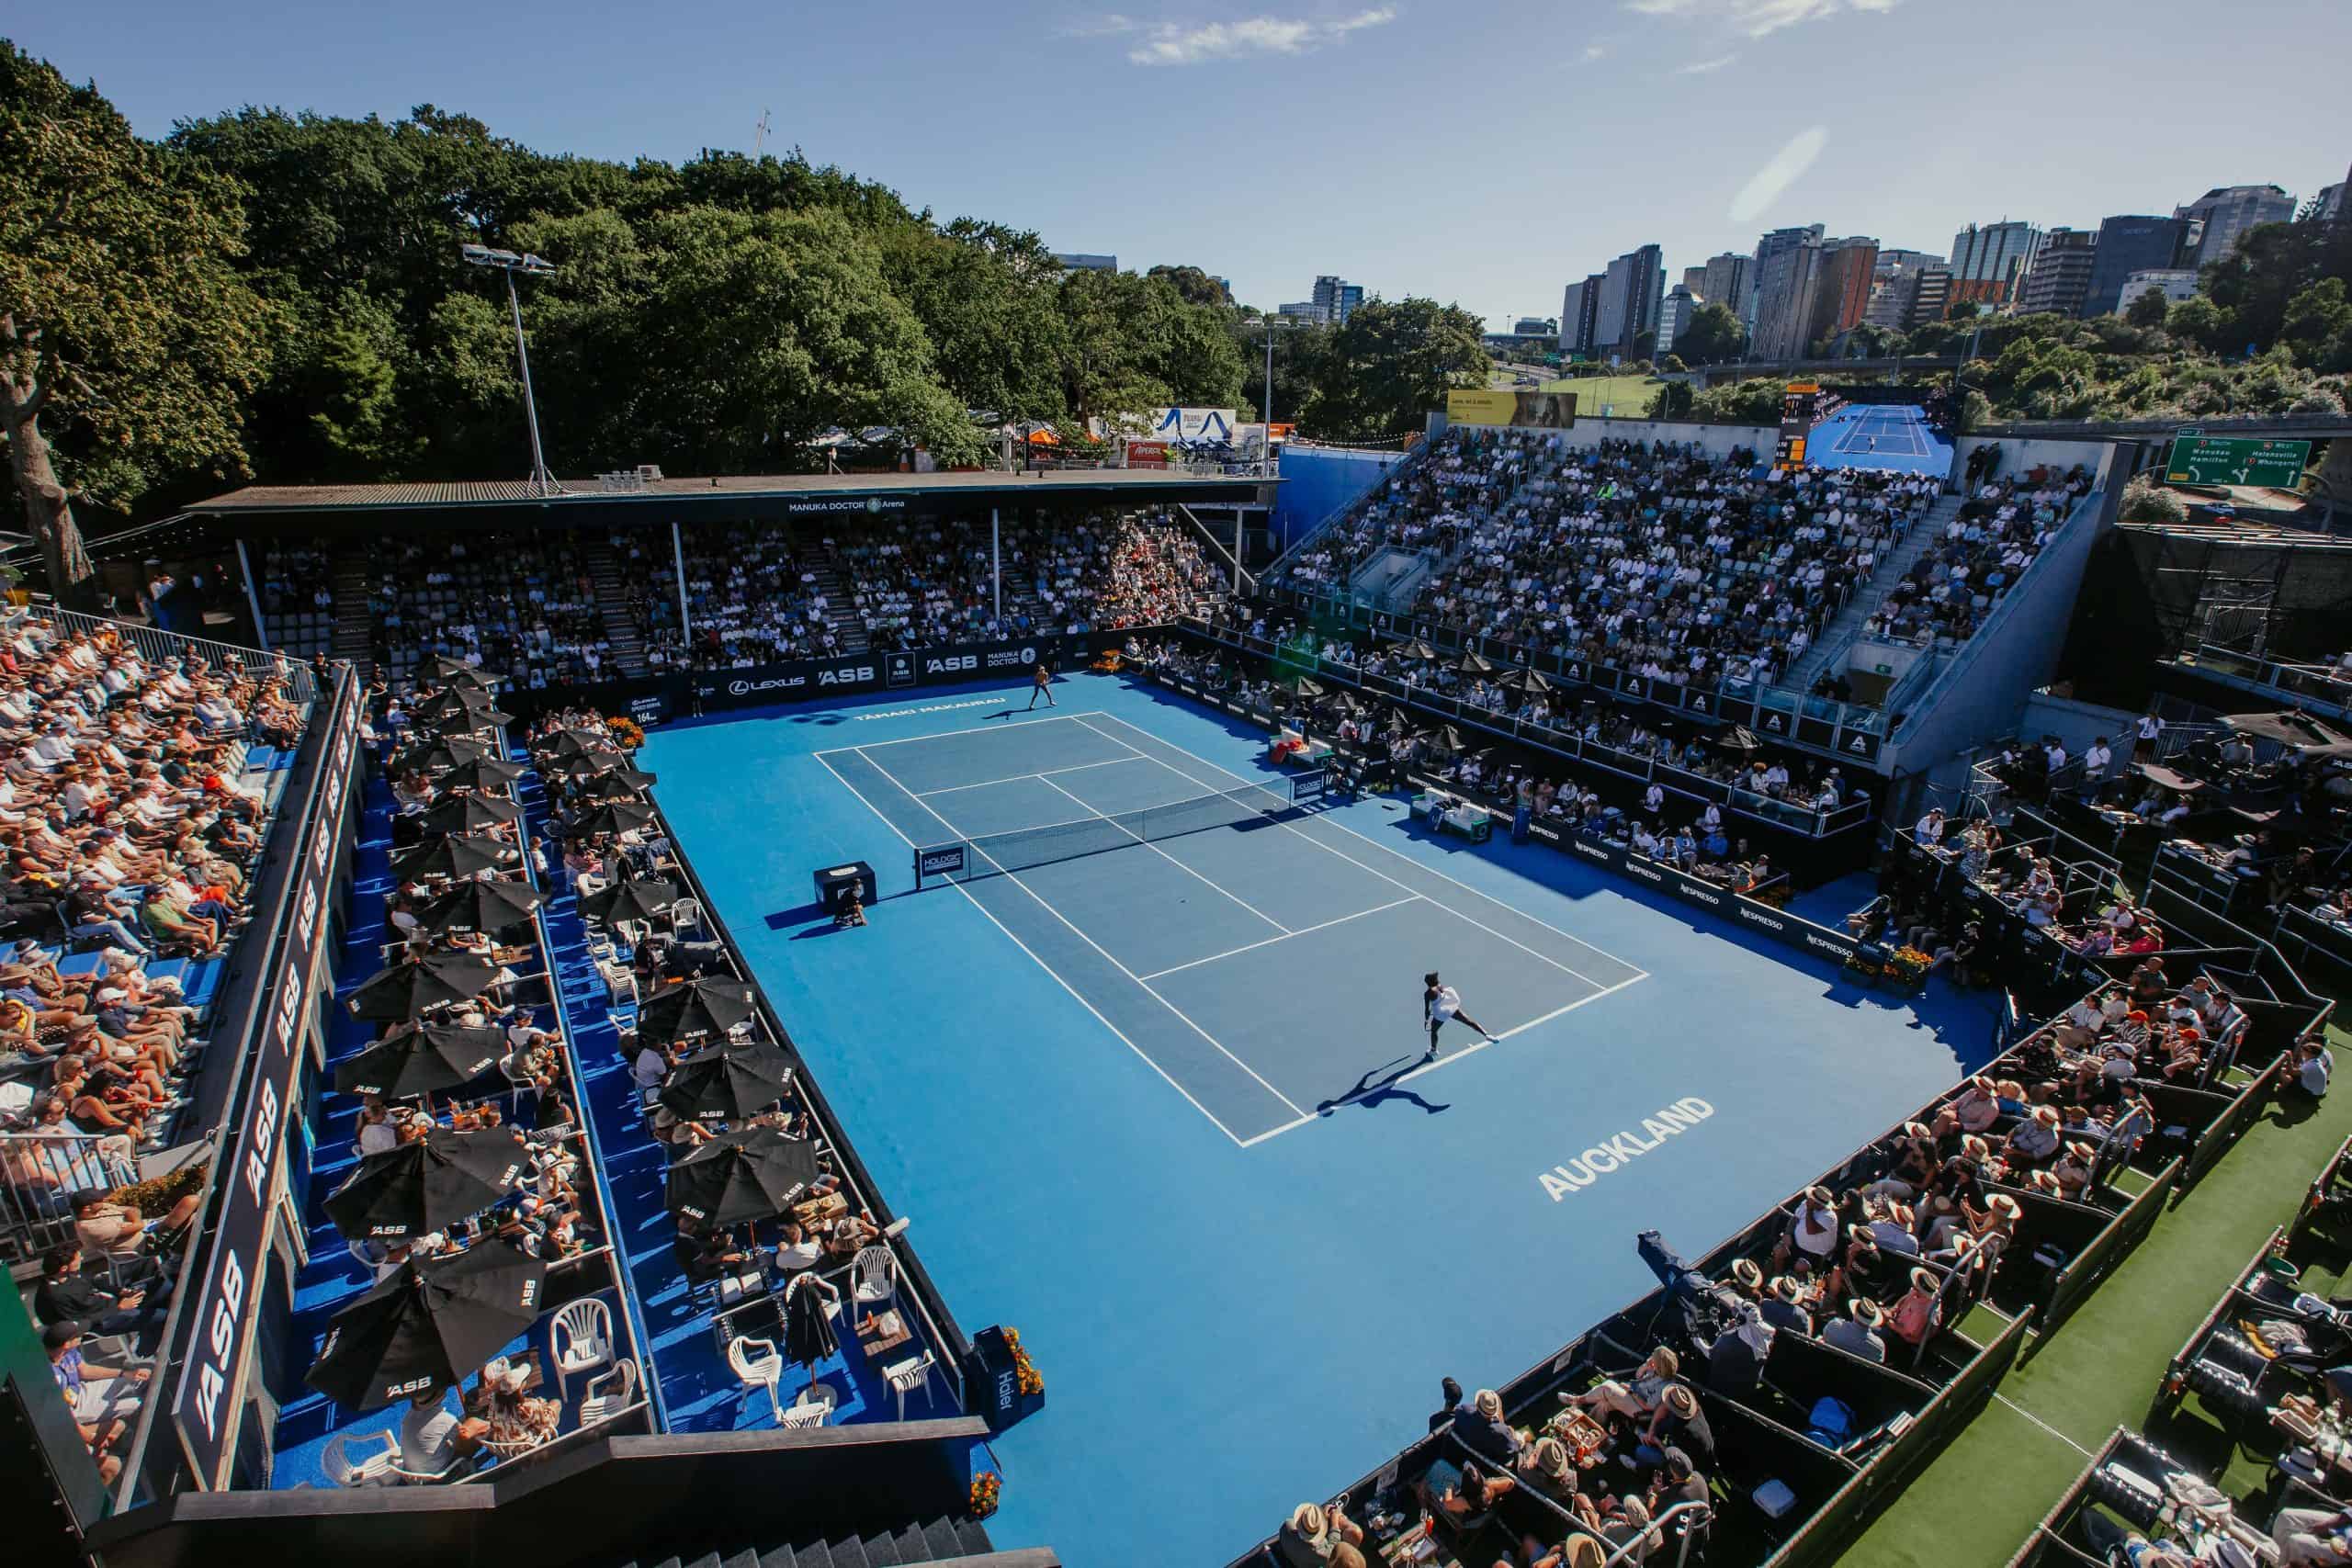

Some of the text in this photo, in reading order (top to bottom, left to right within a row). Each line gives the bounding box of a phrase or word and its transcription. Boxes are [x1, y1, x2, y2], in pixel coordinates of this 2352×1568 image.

[789, 503, 828, 512] MANUKA
[829, 502, 865, 511] DOCTOR
[926, 655, 978, 674] ASB
[987, 651, 1019, 660] MANUKA
[987, 658, 1019, 668] DOCTOR
[750, 676, 806, 691] LEXUS
[818, 666, 875, 686] ASB
[1529, 822, 1559, 840] NESPRESSO
[1575, 840, 1609, 861] NESPRESSO
[1625, 861, 1661, 882] NESPRESSO
[1680, 883, 1719, 905] NESPRESSO
[299, 878, 317, 953] ASB
[1740, 907, 1783, 931] NESPRESSO
[1806, 932, 1853, 958] NESPRESSO
[277, 962, 301, 1057] ASB
[245, 1077, 277, 1208] ASB
[1538, 1097, 1714, 1202] AUCKLAND
[681, 1204, 707, 1220] ASB
[370, 1224, 408, 1235] ASB
[521, 1279, 537, 1307] ASB
[195, 1248, 243, 1442] ASB
[386, 1376, 432, 1398] ASB
[998, 1371, 1013, 1410] Haier
